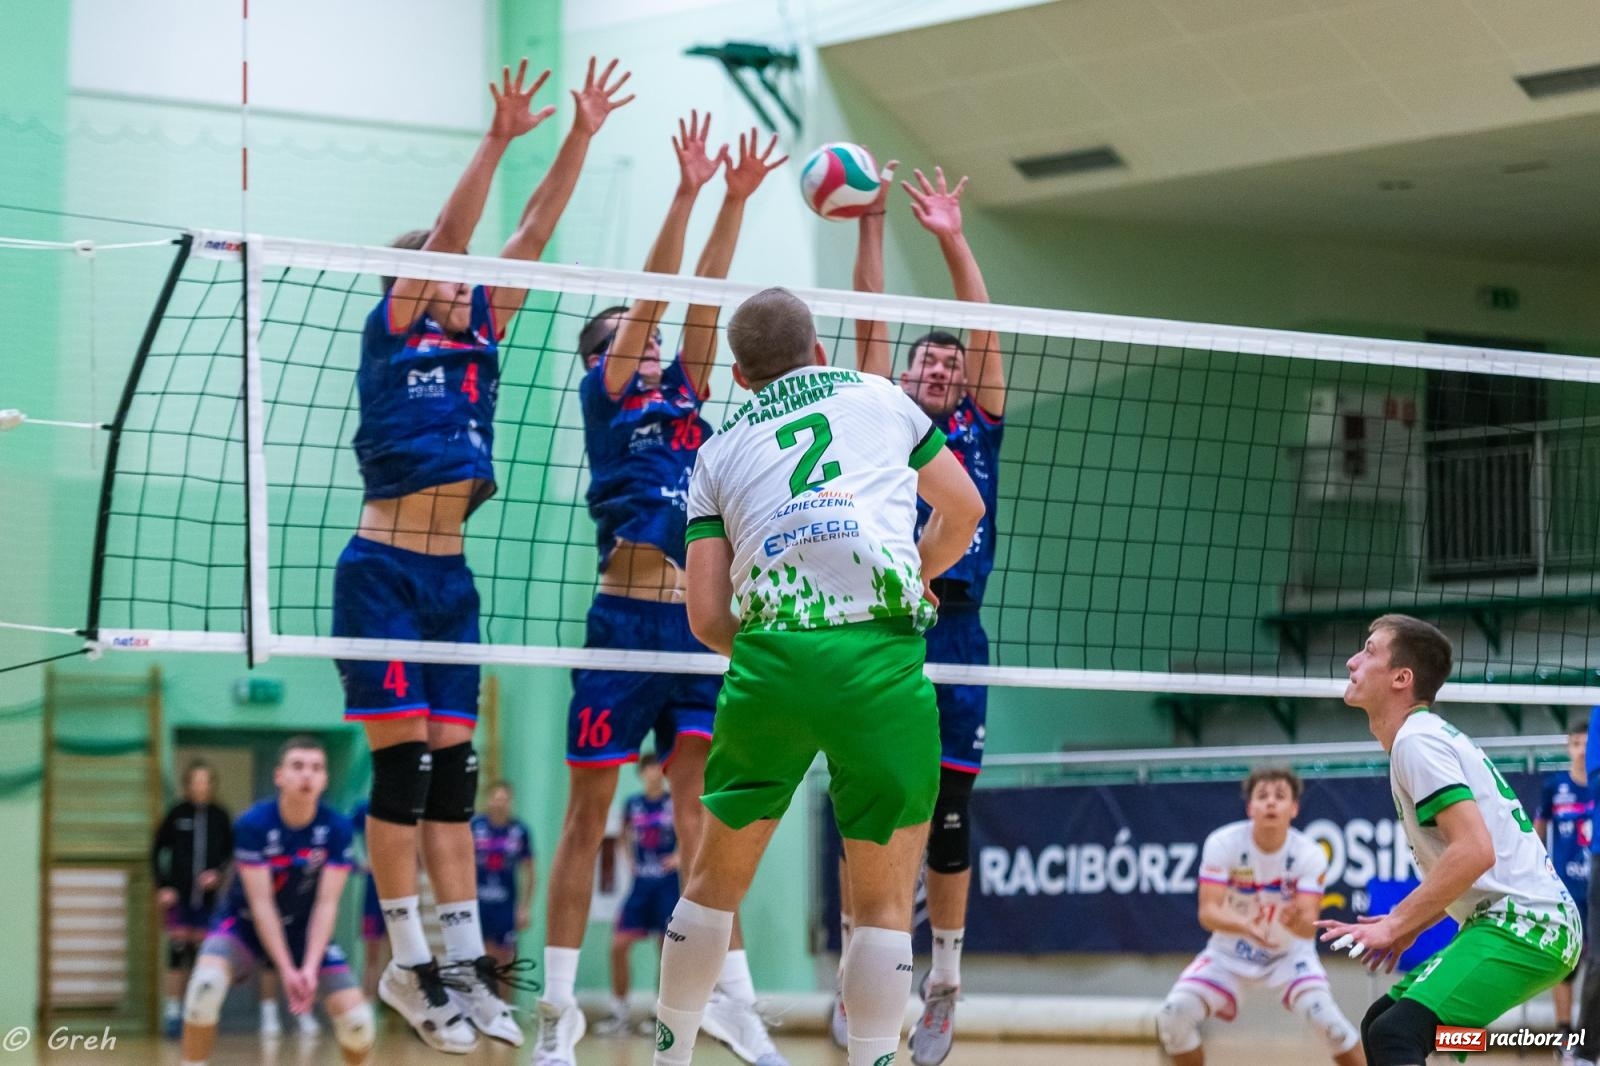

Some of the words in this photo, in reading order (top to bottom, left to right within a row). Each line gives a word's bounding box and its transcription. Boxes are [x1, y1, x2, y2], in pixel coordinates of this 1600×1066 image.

[461, 362, 479, 404] 4
[775, 412, 842, 499] 2
[764, 519, 859, 557] ENTECO
[383, 658, 409, 698] 4
[577, 706, 612, 748] 16
[979, 826, 1198, 896] RACIBÓRZ
